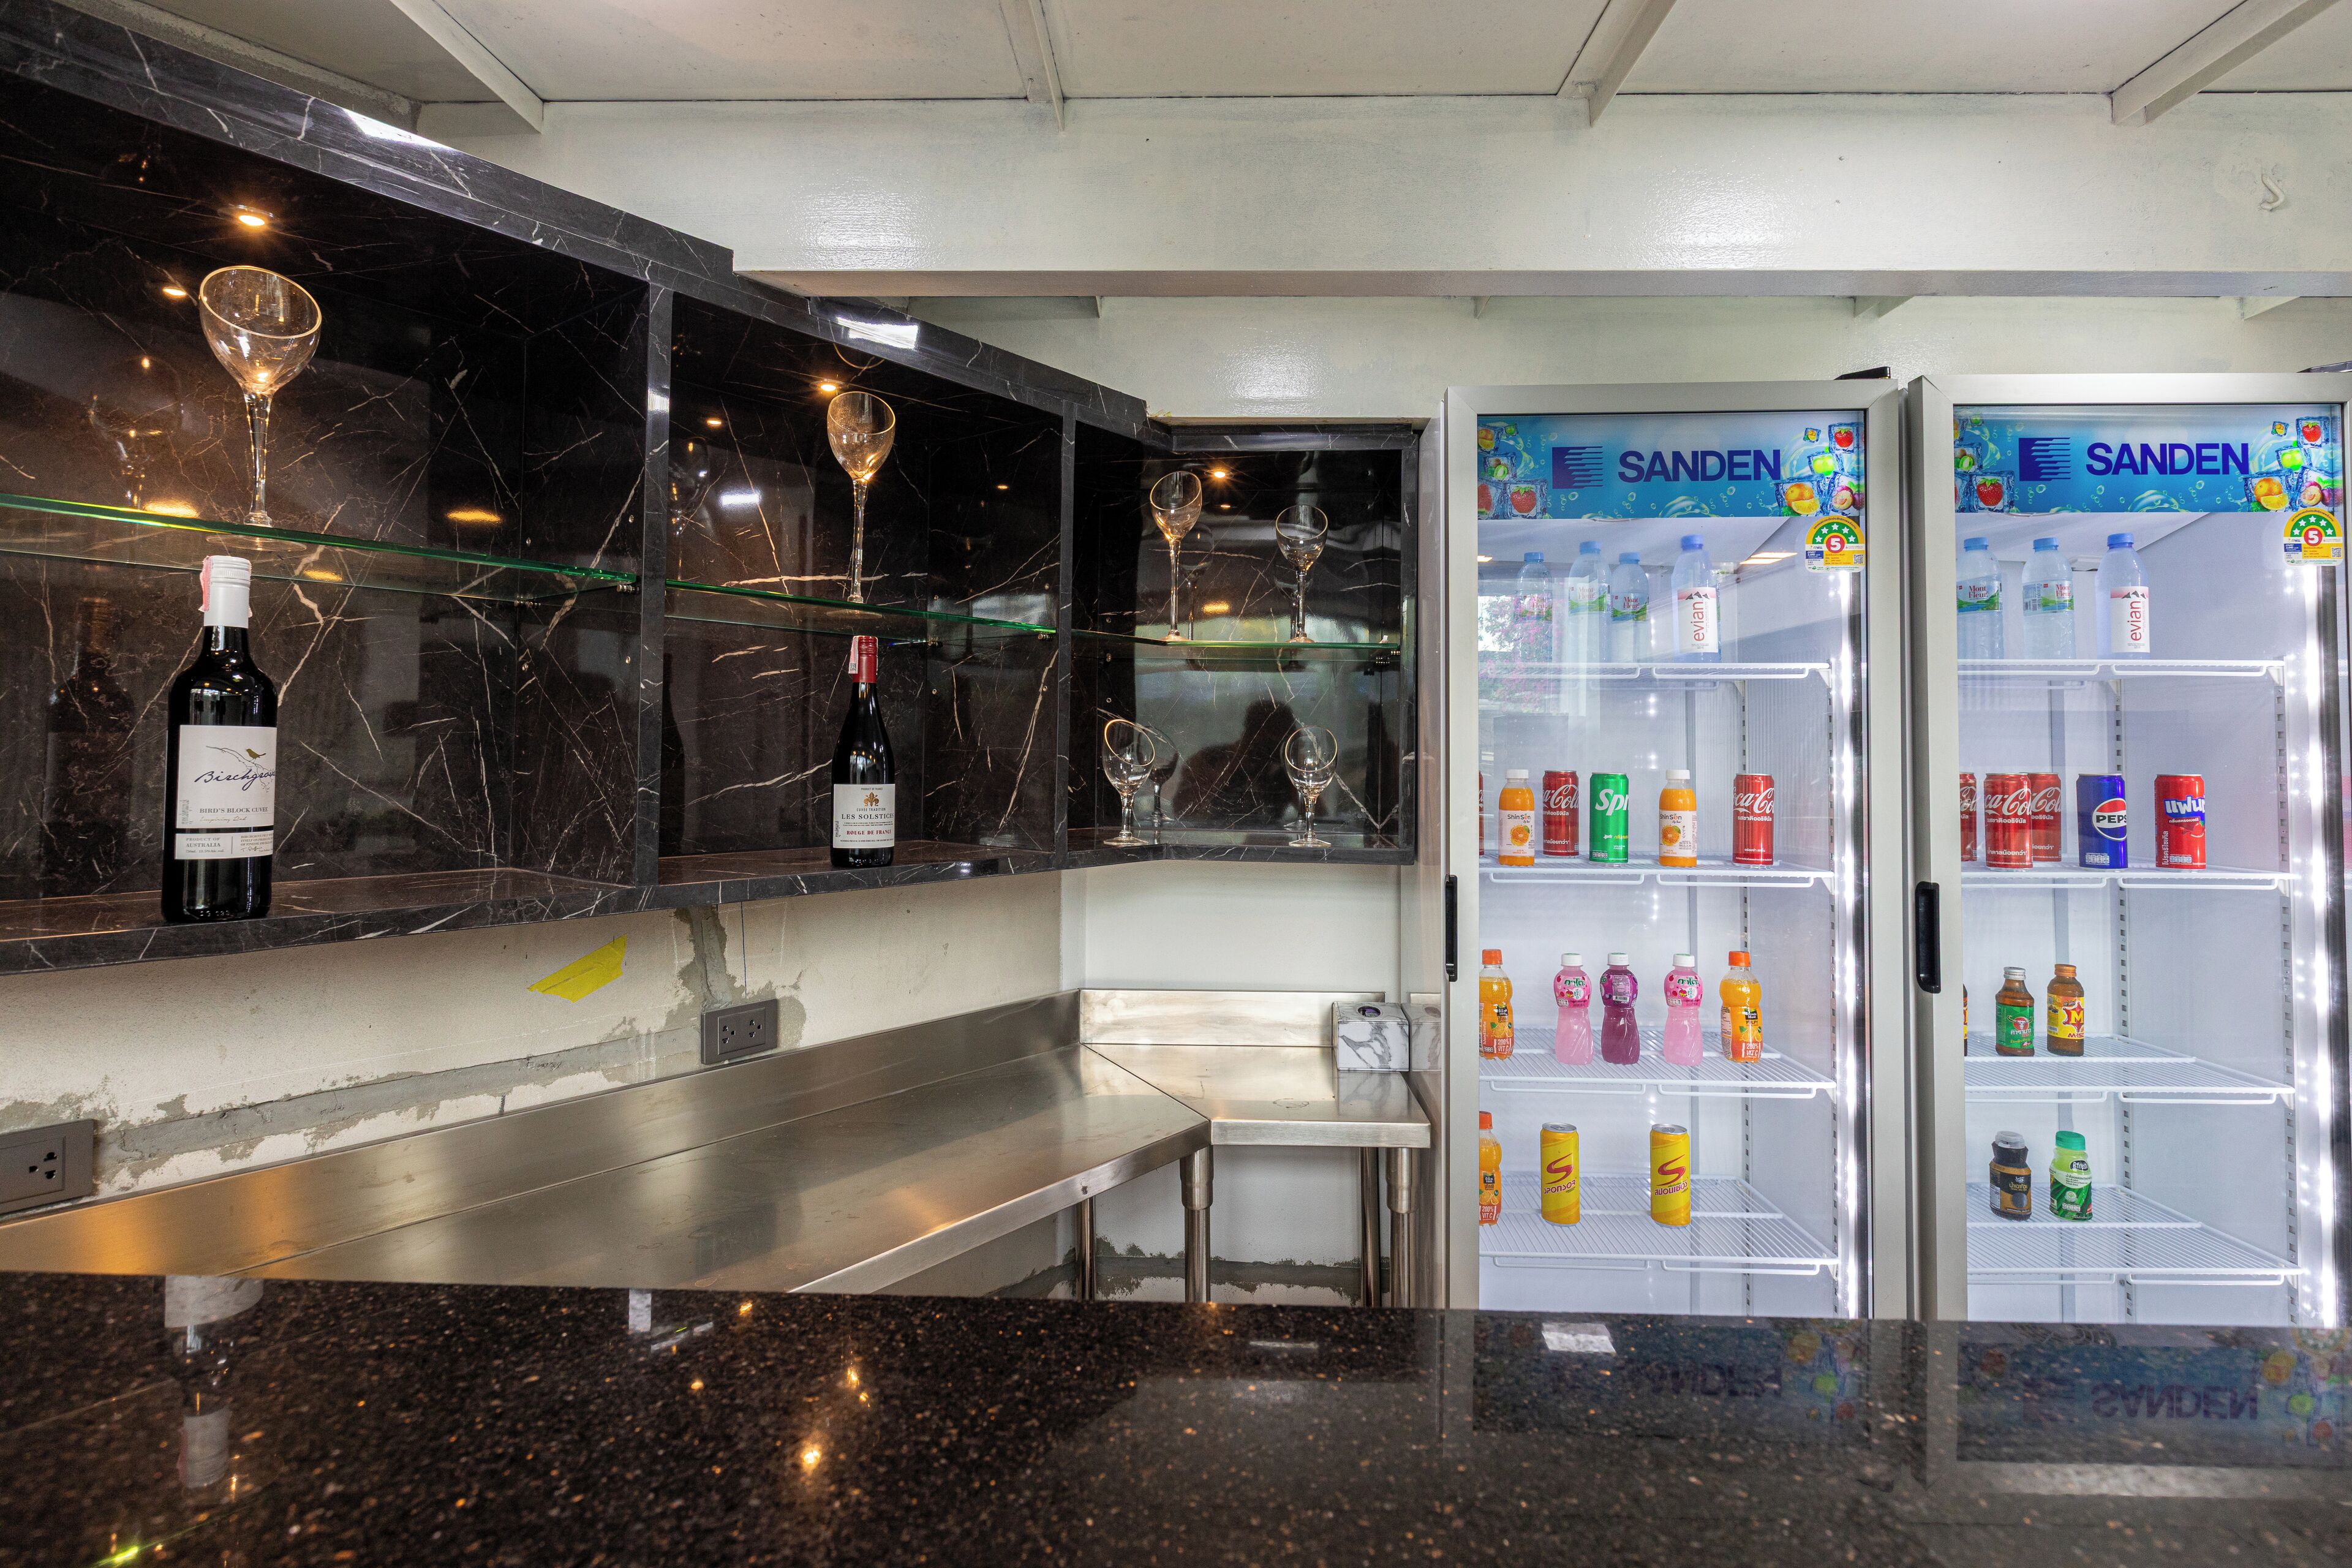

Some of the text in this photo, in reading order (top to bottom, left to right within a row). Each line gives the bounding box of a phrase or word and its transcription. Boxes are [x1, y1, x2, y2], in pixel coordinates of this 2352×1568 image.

[1618, 448, 1781, 483] SANDEN
[2086, 442, 2250, 477] SANDEN
[1830, 537, 1842, 551] 5
[2307, 530, 2320, 545] 5
[1690, 601, 1705, 642] evian
[2127, 600, 2142, 641] evian
[2070, 1010, 2084, 1023] M
